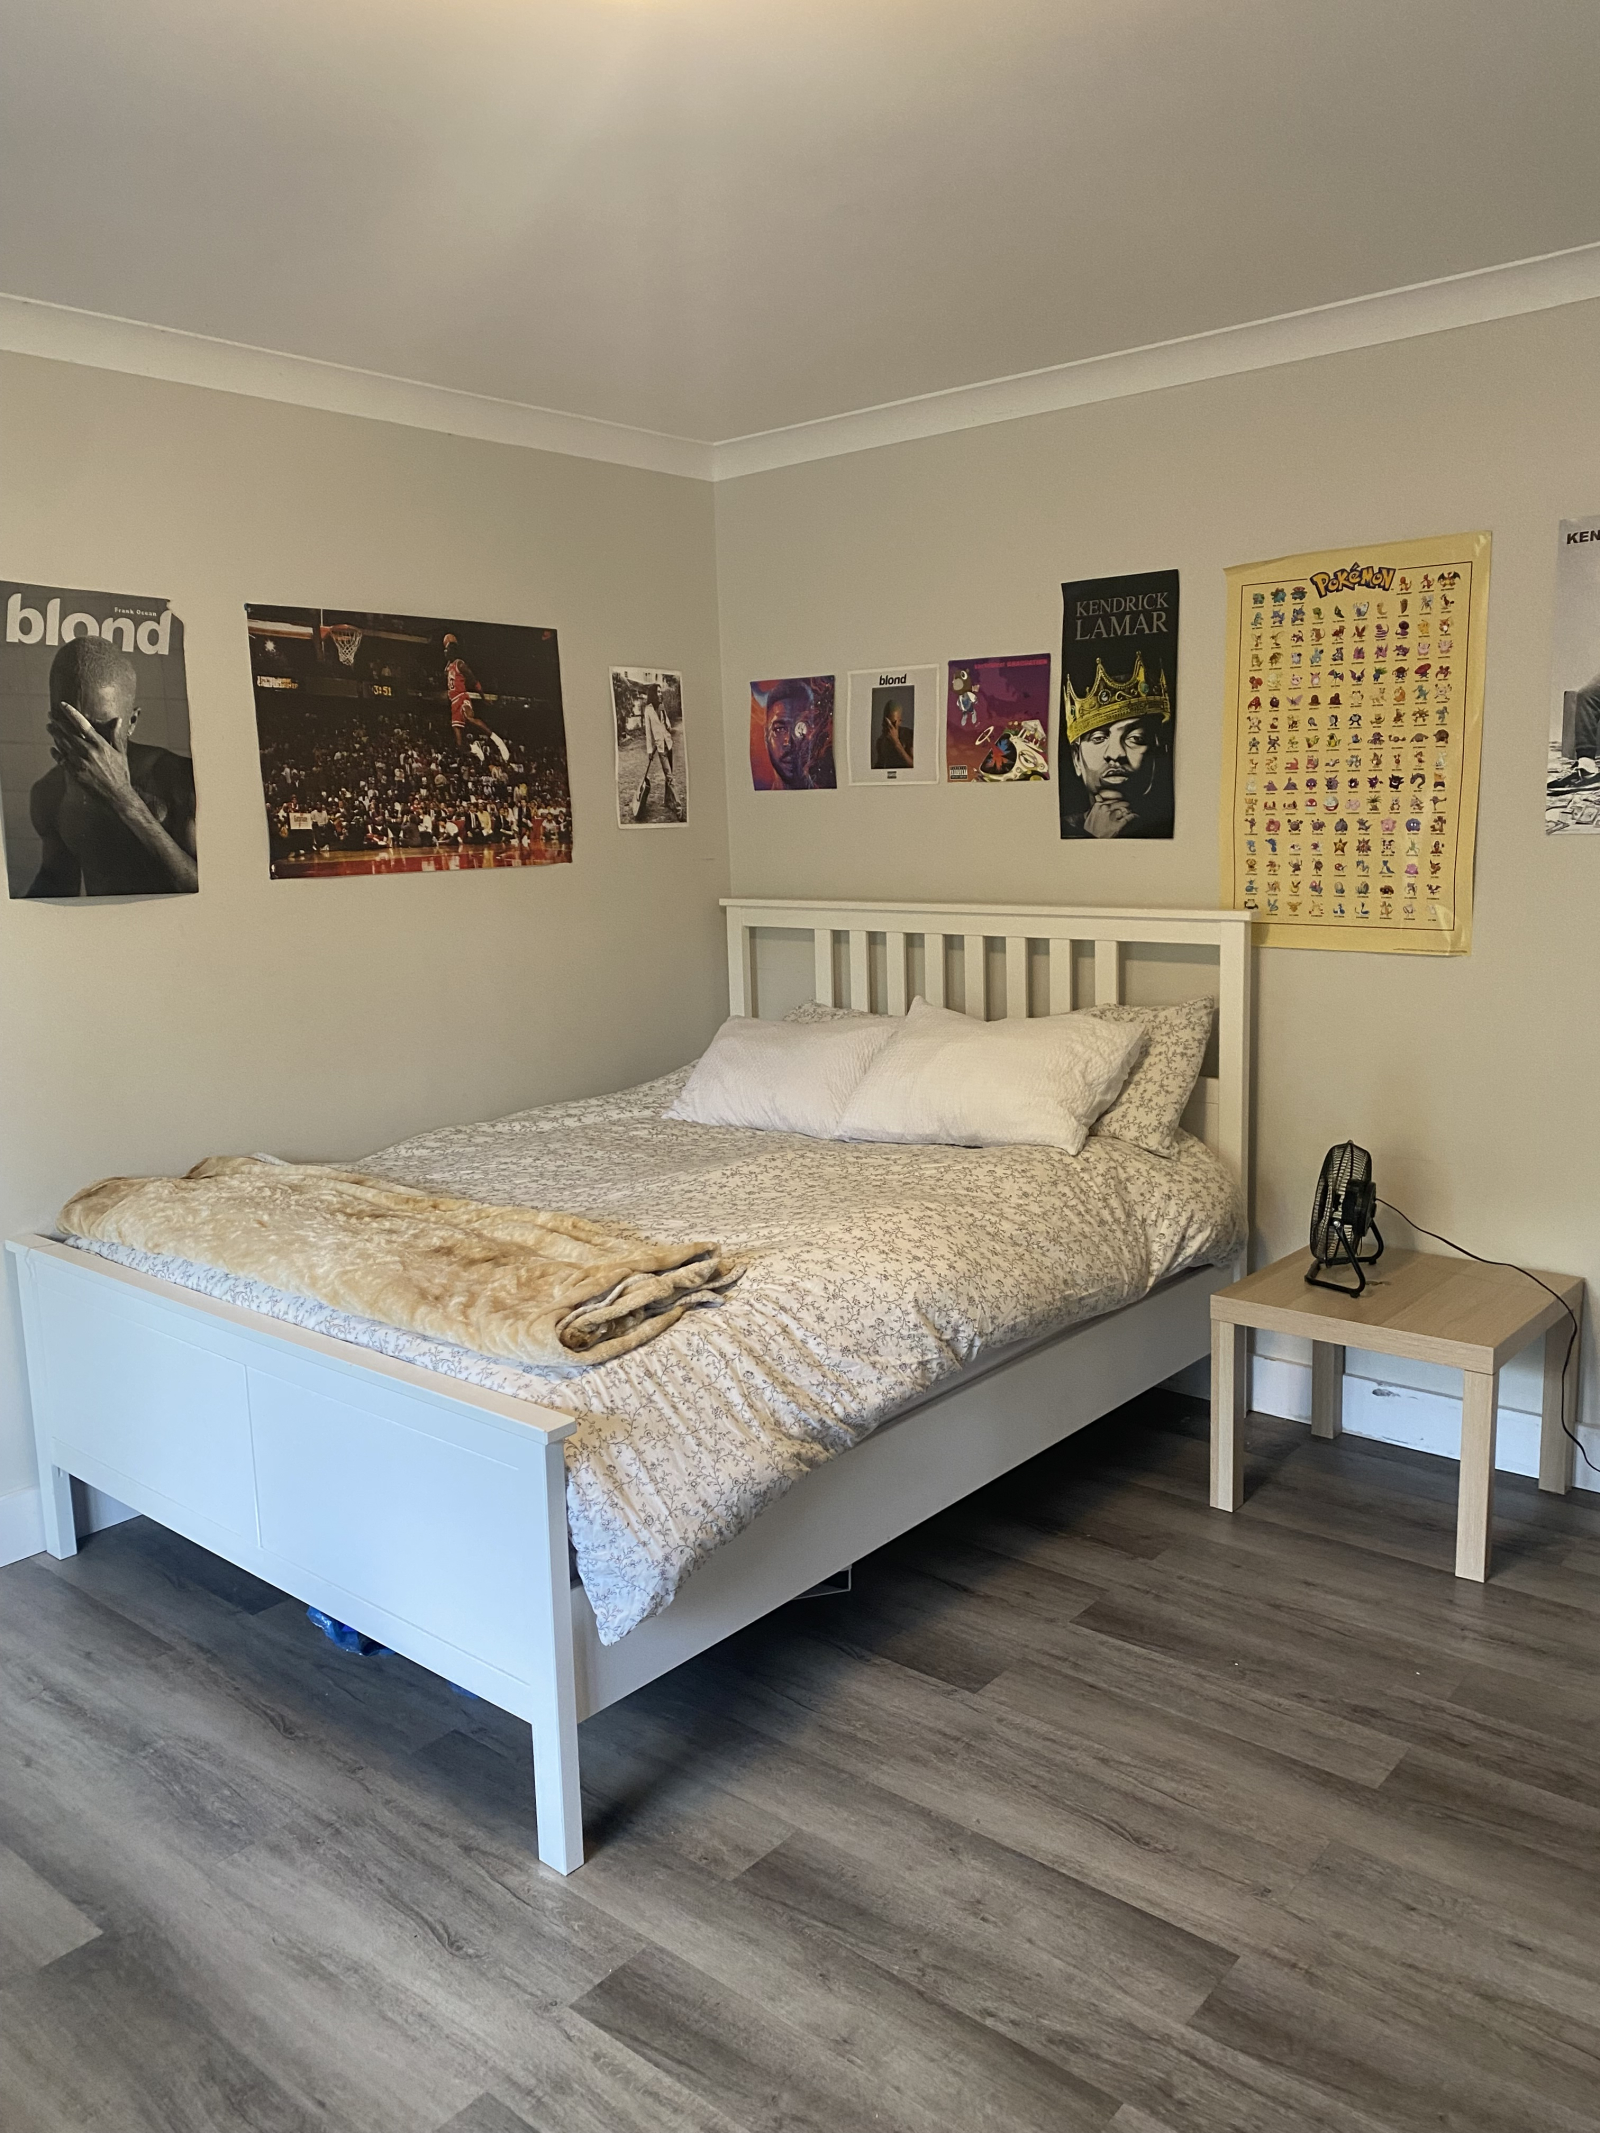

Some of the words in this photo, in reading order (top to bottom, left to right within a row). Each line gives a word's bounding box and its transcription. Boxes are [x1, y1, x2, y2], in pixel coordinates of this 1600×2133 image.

[114, 606, 134, 615] Frank
[1075, 592, 1169, 617] KENDRICK
[6, 593, 172, 655] blond
[1075, 611, 1169, 640] LAMAR
[879, 673, 907, 686] blond
[373, 685, 392, 696] 3:51
